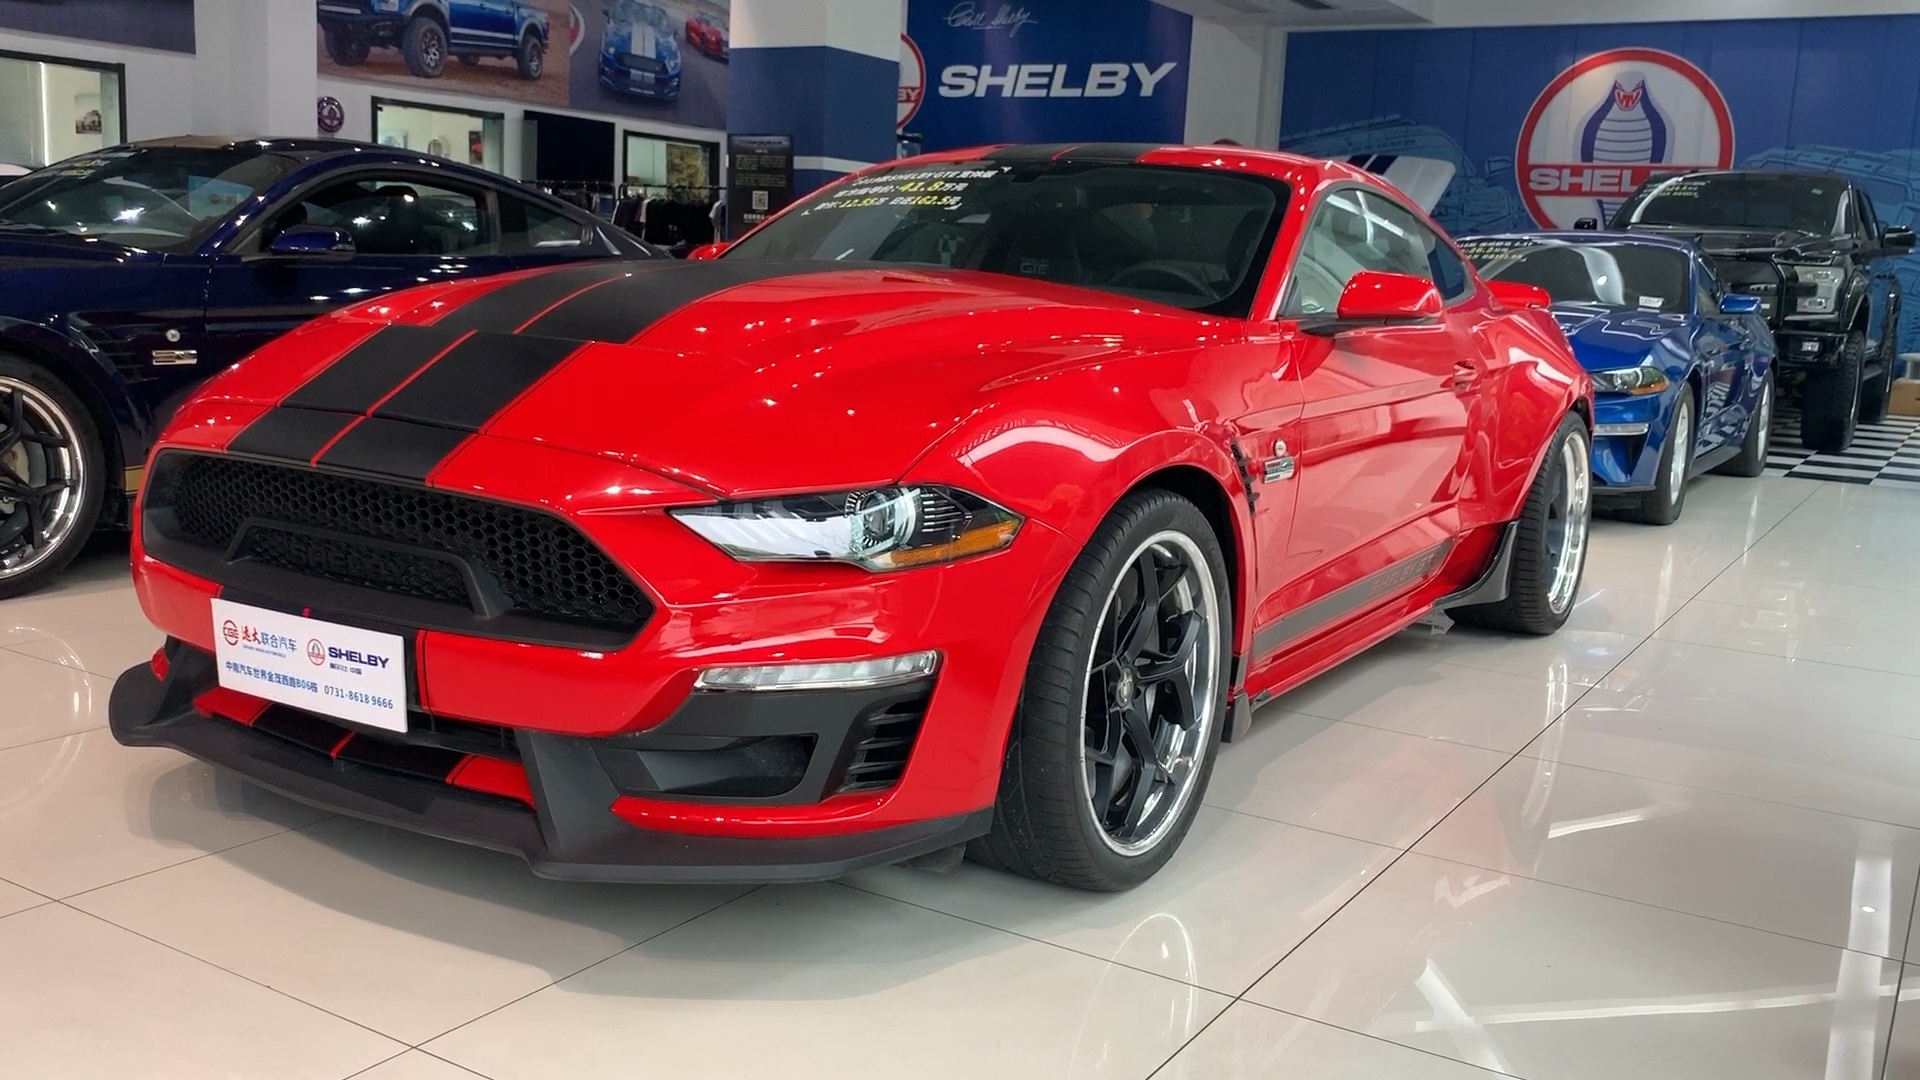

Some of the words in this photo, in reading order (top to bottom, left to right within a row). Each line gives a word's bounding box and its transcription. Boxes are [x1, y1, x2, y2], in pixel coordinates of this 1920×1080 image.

[938, 62, 1177, 98] SHELBY
[1529, 167, 1672, 192] SHEL
[328, 646, 389, 669] SHELBY
